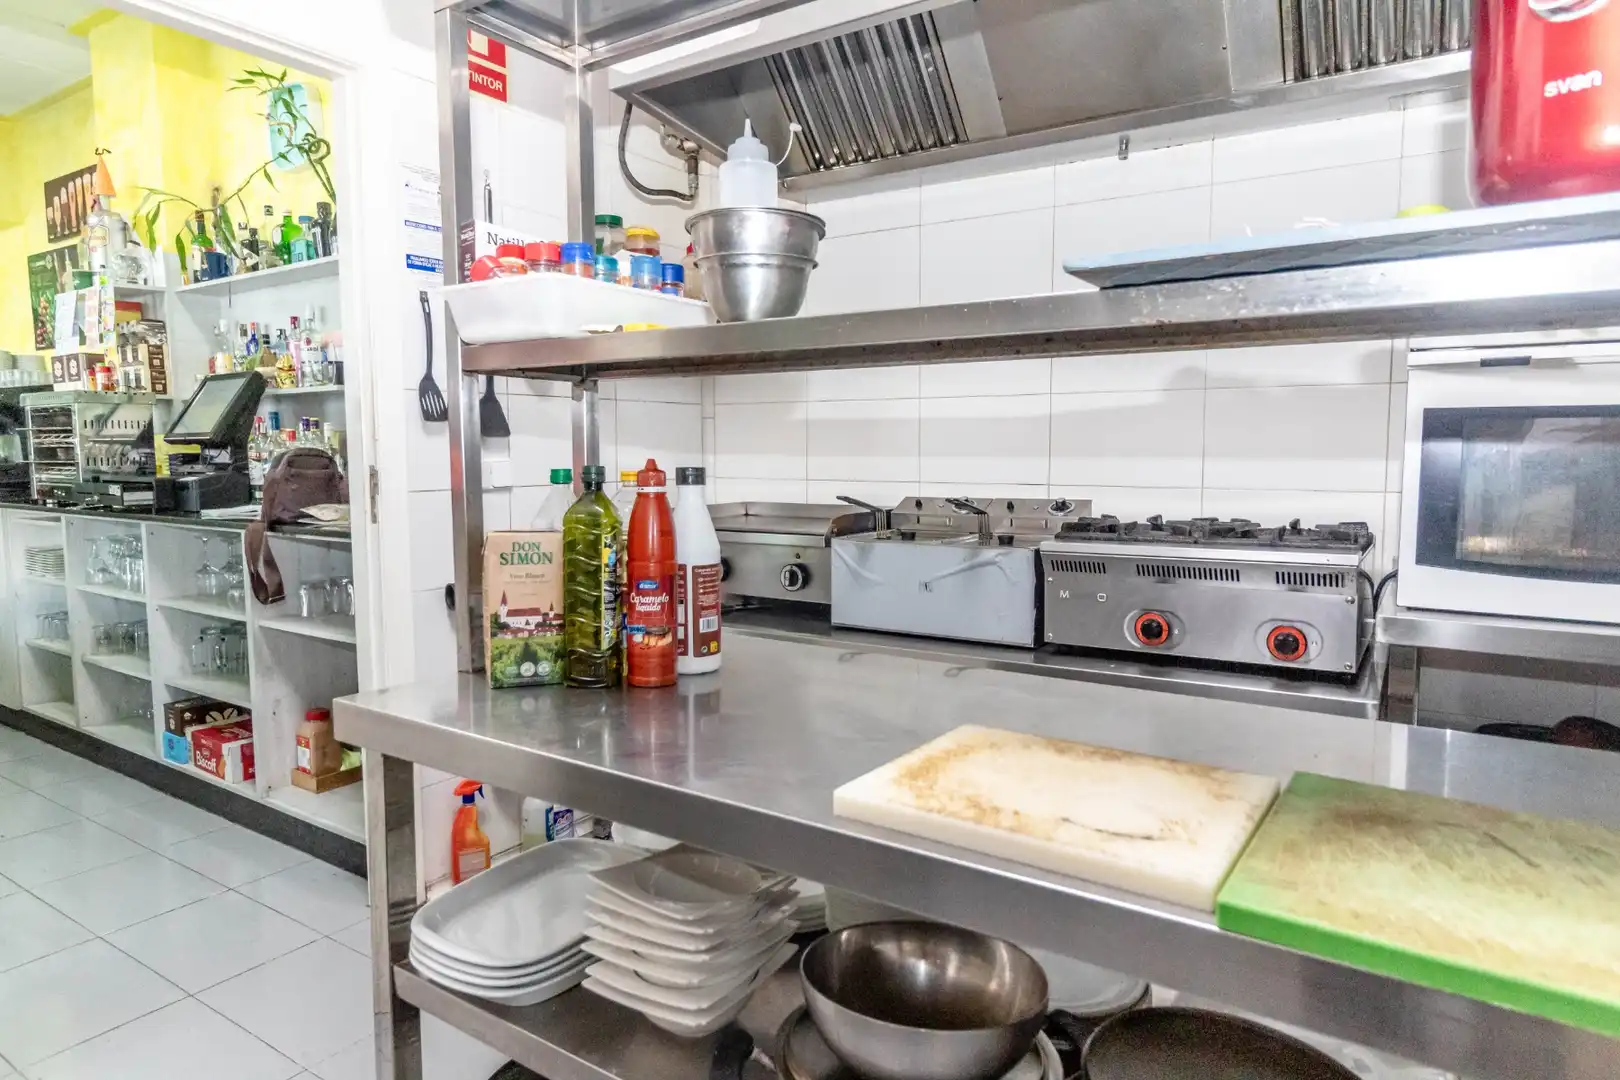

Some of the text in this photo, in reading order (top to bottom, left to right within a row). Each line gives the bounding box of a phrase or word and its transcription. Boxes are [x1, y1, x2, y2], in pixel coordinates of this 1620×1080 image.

[468, 69, 503, 93] TINTOR
[512, 541, 541, 552] DON
[499, 551, 553, 566] SIMON
[630, 592, 670, 604] Caramelo
[195, 750, 217, 773] Biscoff
